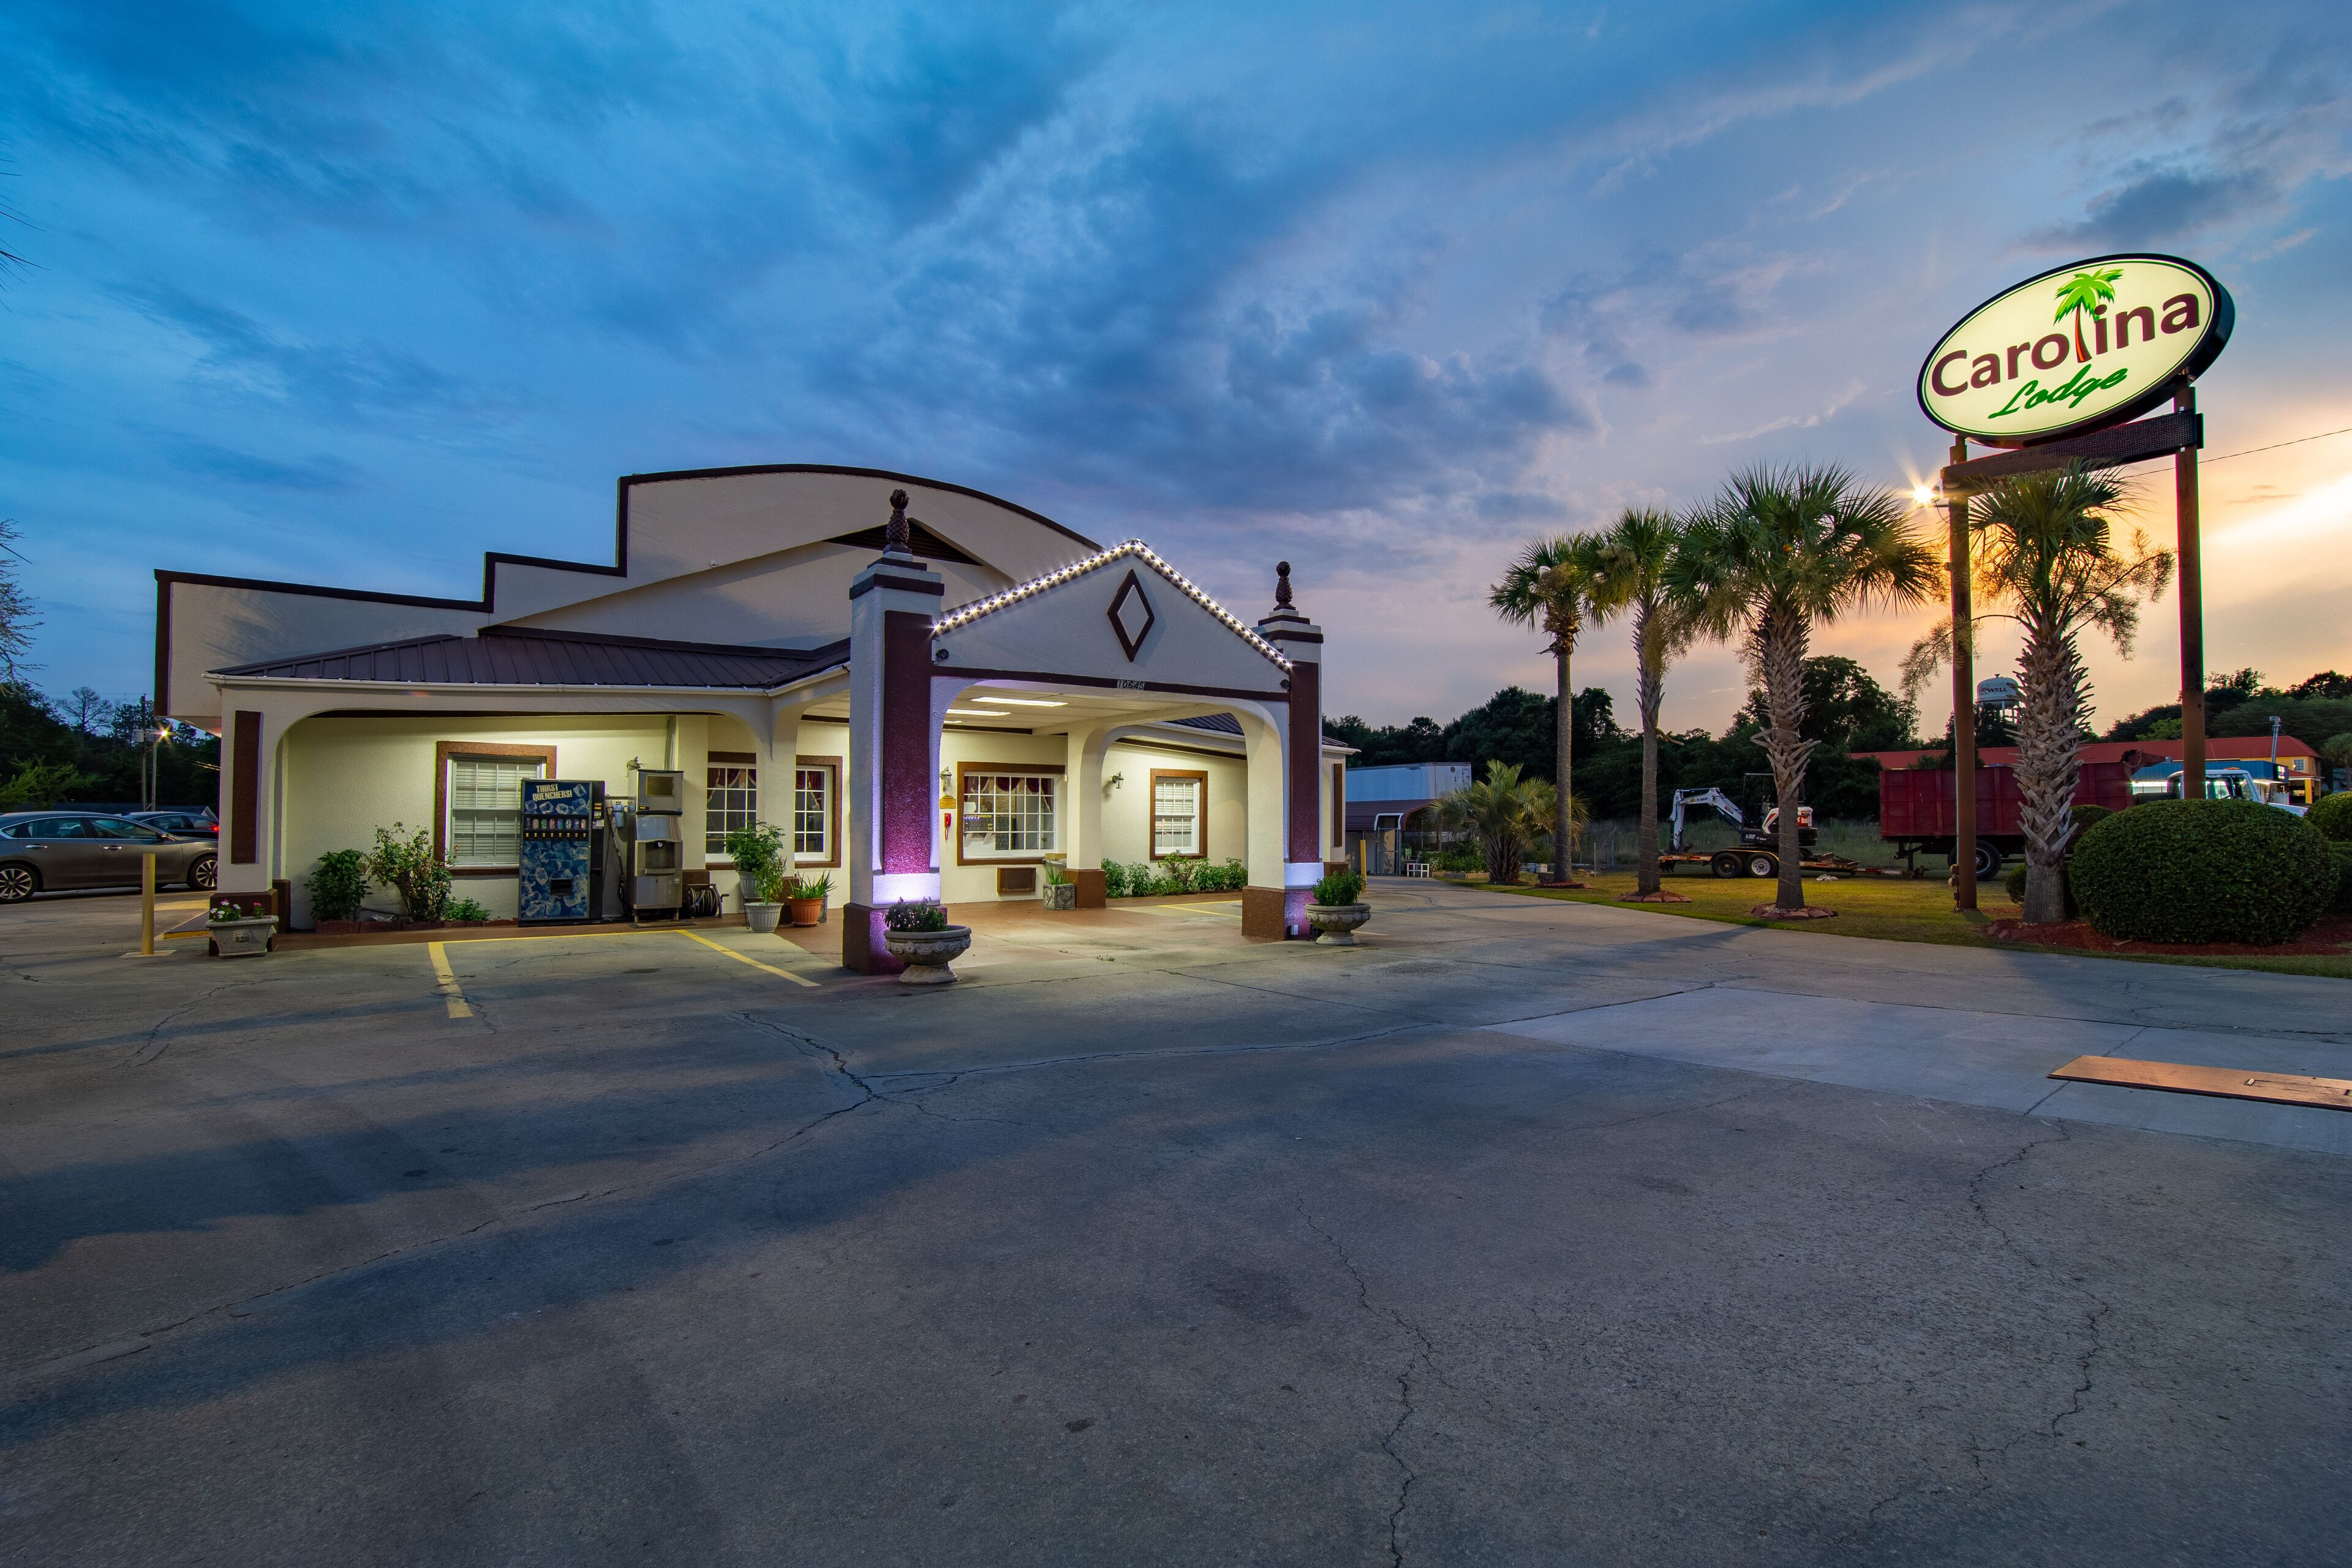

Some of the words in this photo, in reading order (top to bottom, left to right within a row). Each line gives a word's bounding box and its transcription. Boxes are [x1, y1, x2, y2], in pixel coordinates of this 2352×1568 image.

[1931, 293, 2201, 397] Carolina
[1988, 364, 2128, 419] Lodge
[1118, 680, 1144, 690] 10645
[535, 784, 559, 793] THIRST
[532, 790, 573, 802] QUENCHERS!
